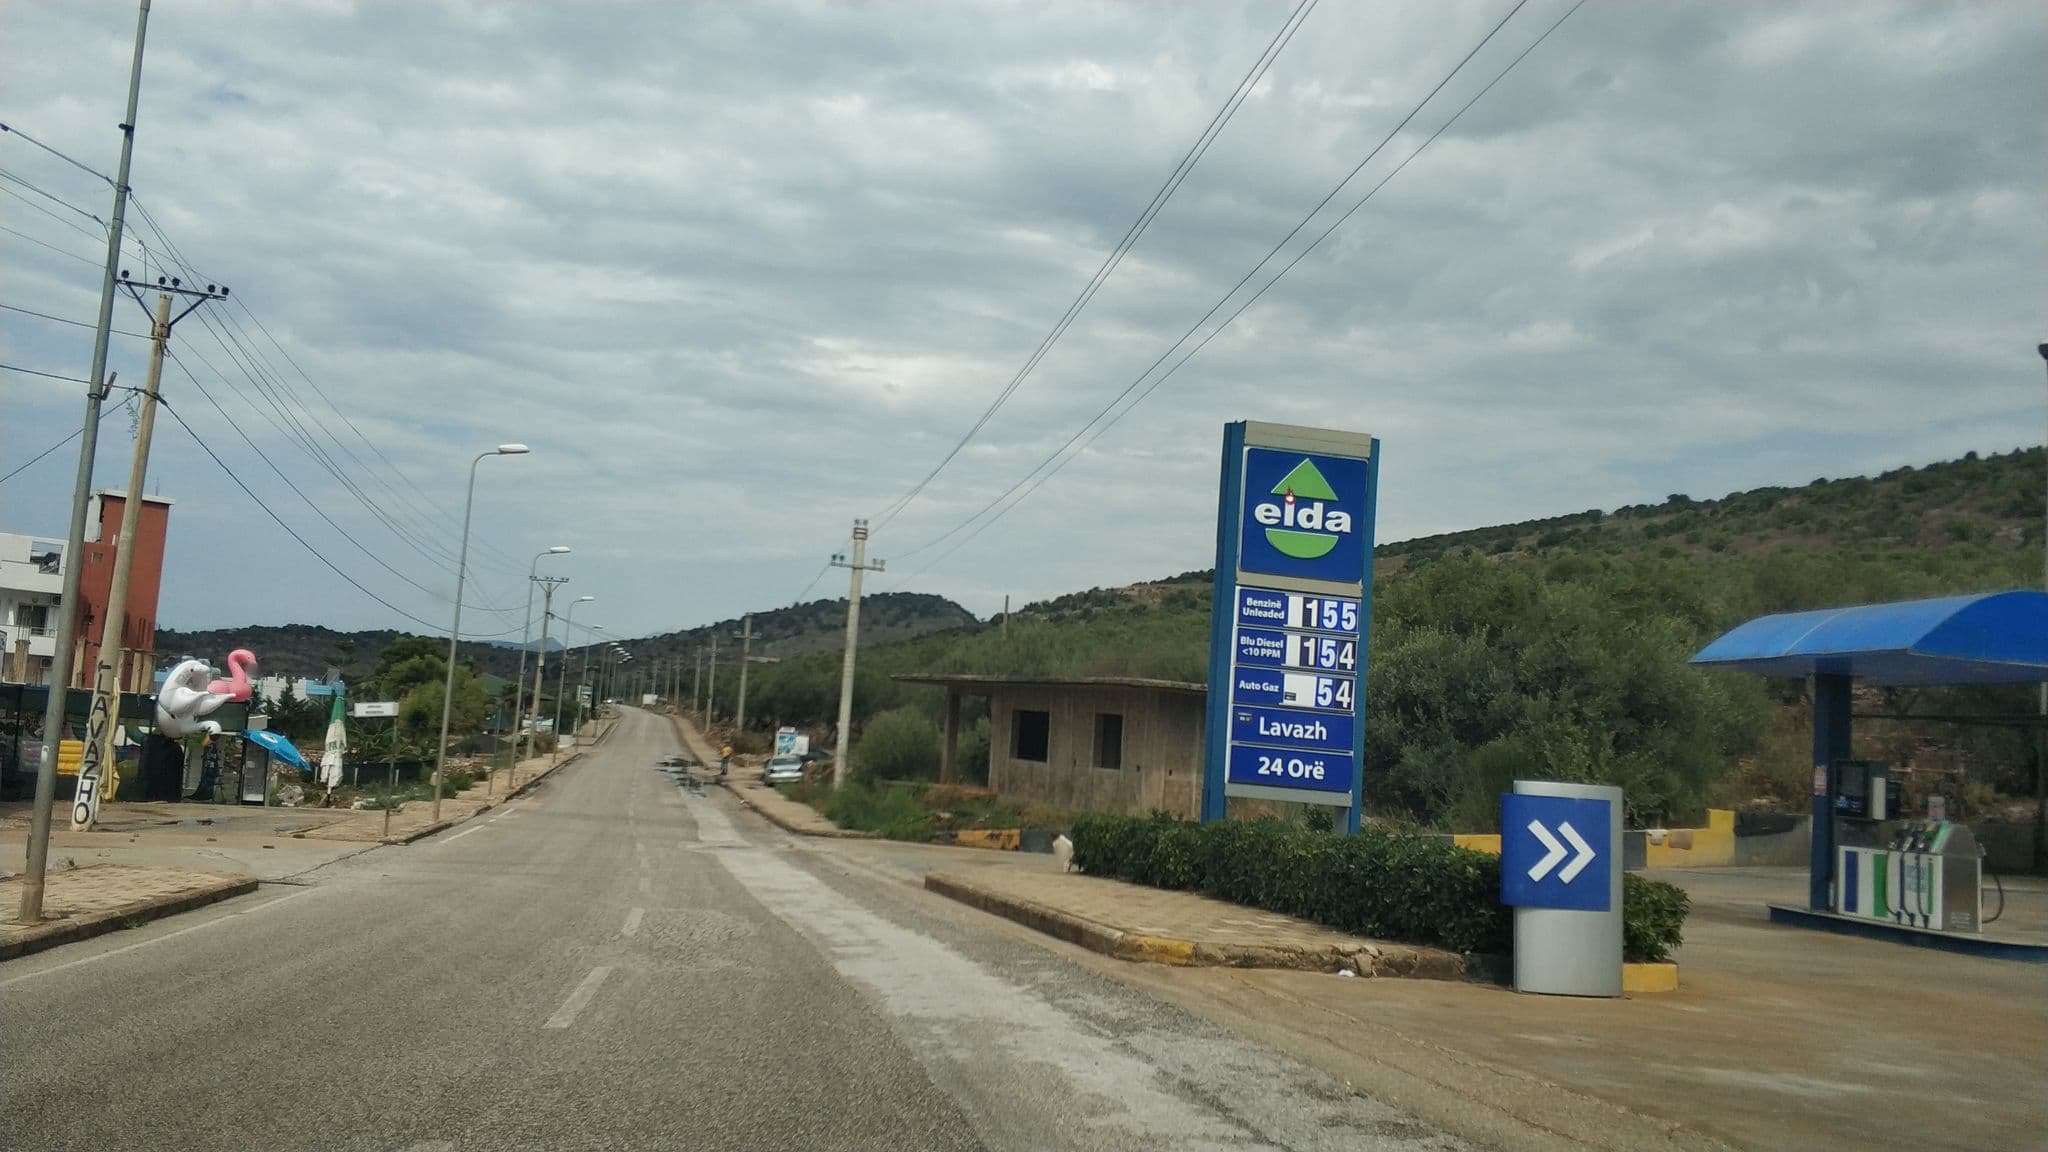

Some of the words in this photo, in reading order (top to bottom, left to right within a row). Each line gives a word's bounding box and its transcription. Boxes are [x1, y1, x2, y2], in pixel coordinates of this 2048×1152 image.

[1254, 494, 1352, 533] eida
[1242, 607, 1285, 619] Unleaded
[1246, 597, 1282, 609] Benzinë
[1305, 599, 1357, 630] 155
[1240, 636, 1255, 646] Blu
[1256, 637, 1284, 649] Diesel
[1242, 648, 1260, 657] <10
[1260, 649, 1281, 659] PPM
[1303, 638, 1355, 670] 154
[1239, 680, 1261, 690] Auto
[1262, 682, 1279, 692] Gaz
[1317, 678, 1351, 708] 54
[1259, 716, 1327, 740] Lavazh
[1257, 756, 1284, 776] 24
[1287, 759, 1325, 780] Orë
